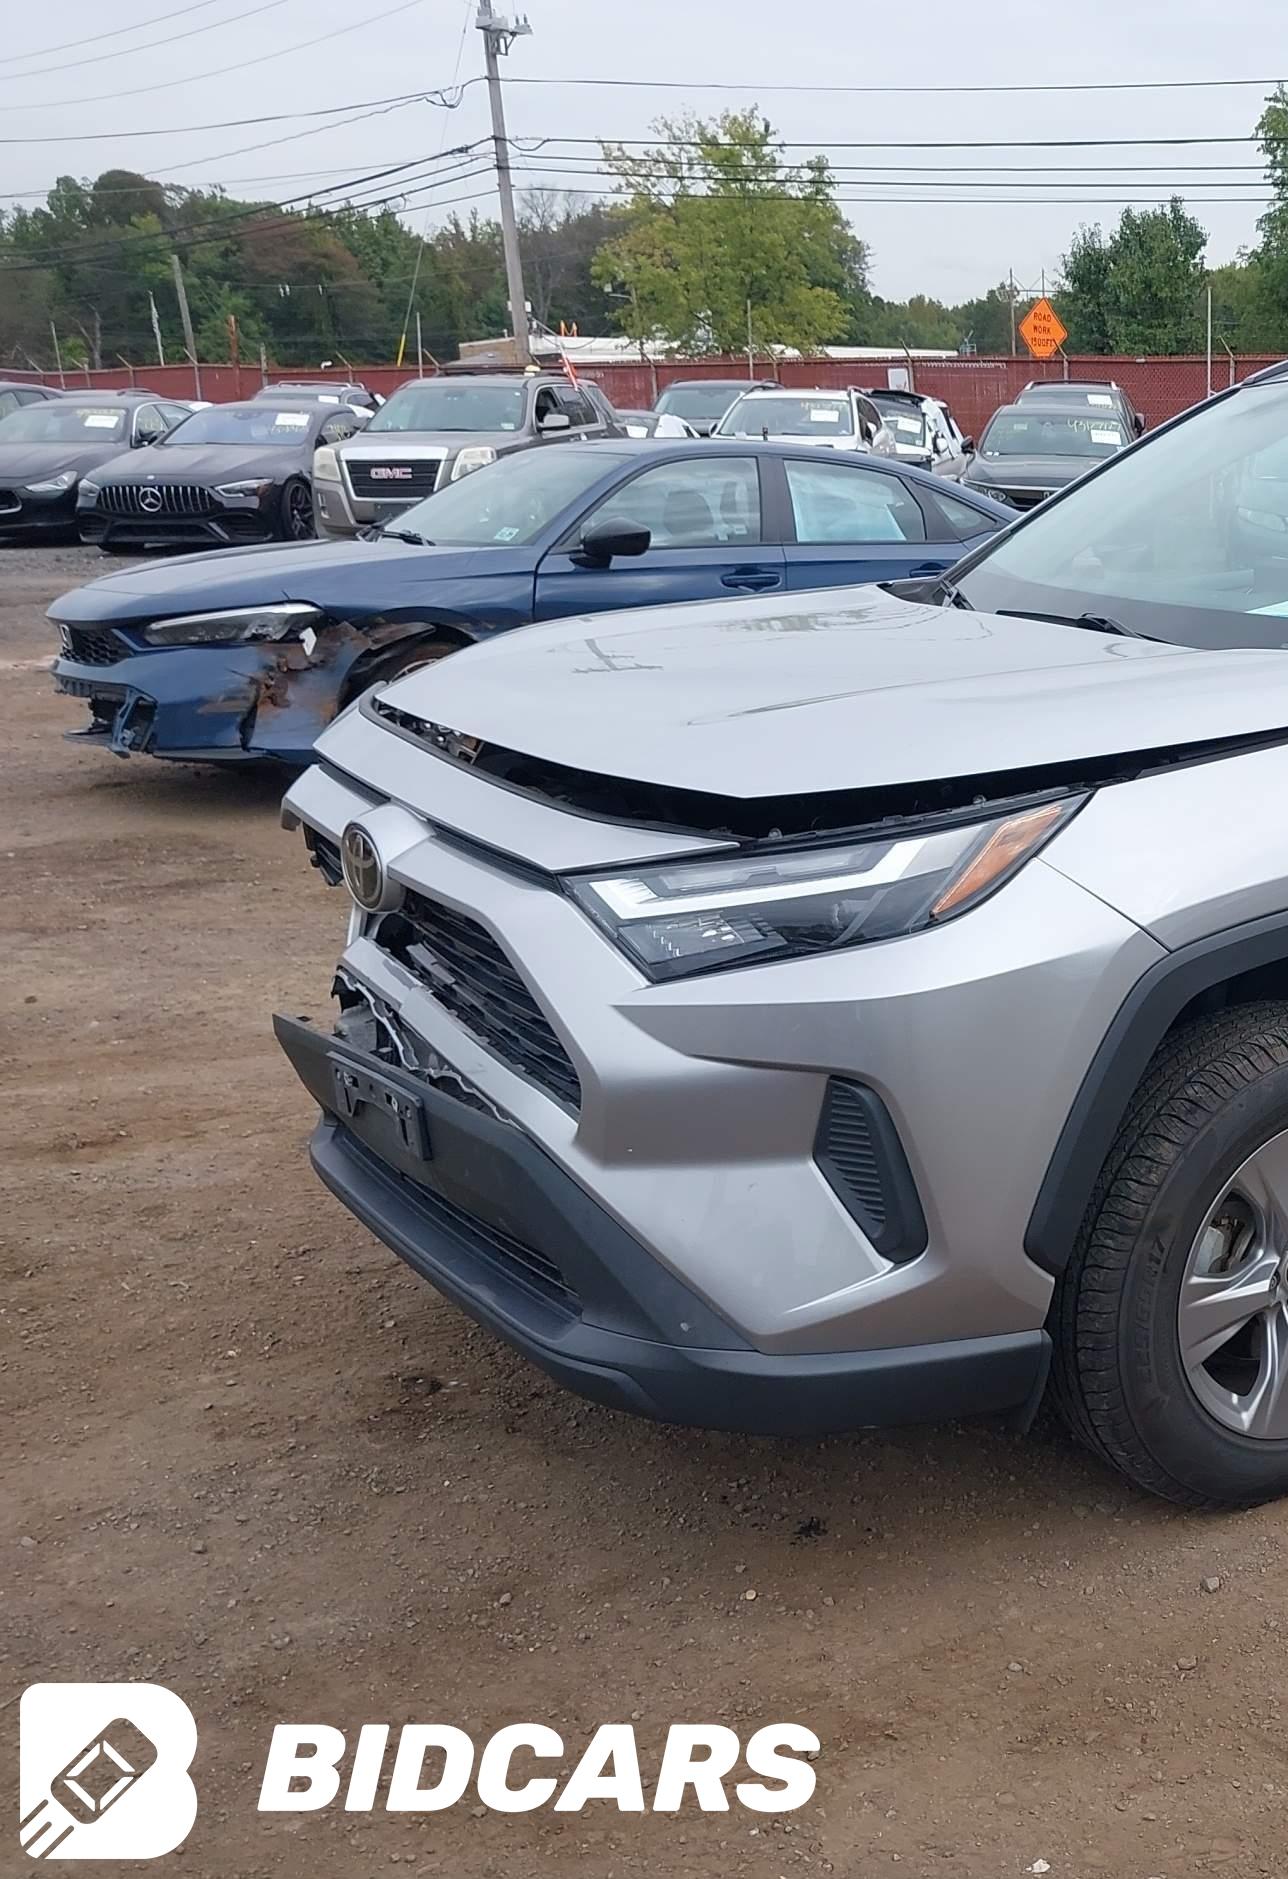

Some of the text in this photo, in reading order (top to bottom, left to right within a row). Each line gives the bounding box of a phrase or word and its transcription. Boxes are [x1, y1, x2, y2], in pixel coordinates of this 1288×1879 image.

[1033, 311, 1052, 323] ROAD
[1033, 325, 1051, 335] WORK
[370, 467, 413, 479] GMC
